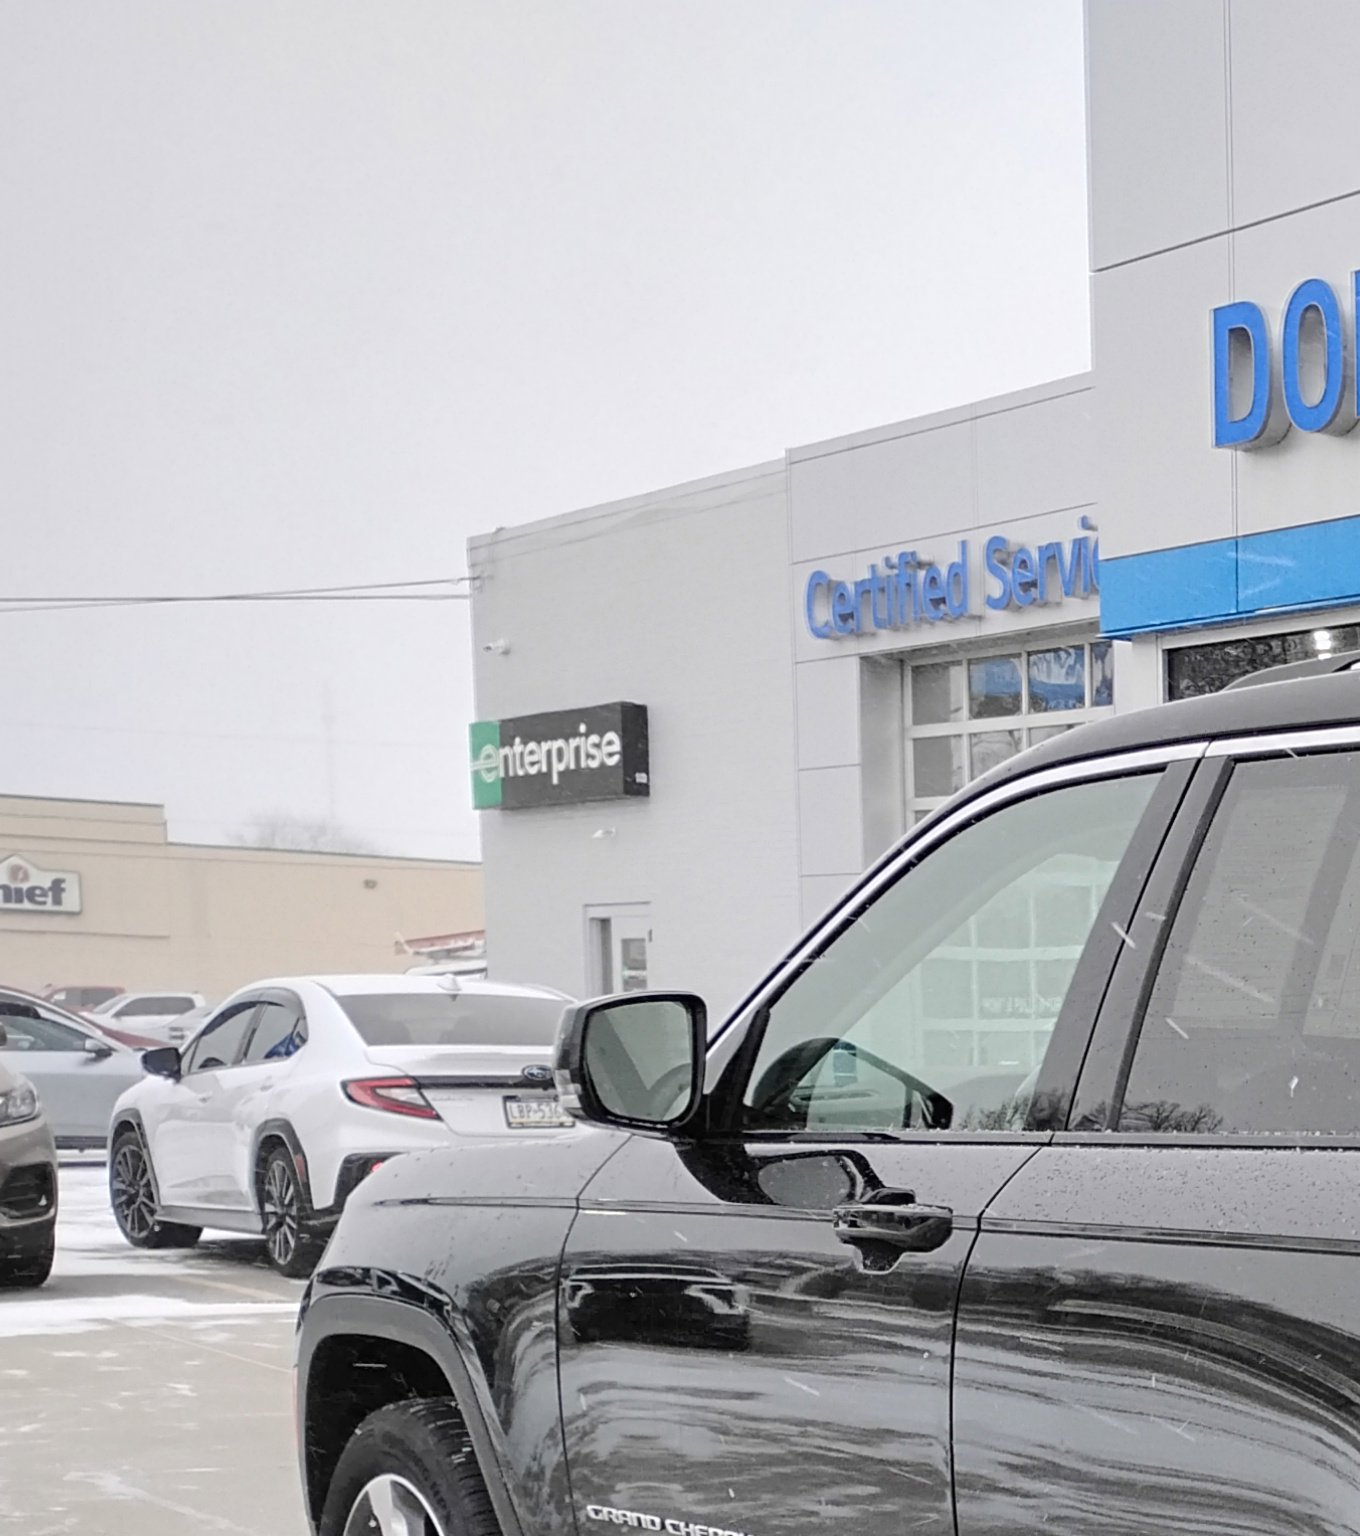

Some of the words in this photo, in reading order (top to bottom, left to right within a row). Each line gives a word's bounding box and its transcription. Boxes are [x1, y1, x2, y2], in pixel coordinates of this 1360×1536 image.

[805, 540, 971, 640] Certified
[984, 514, 1099, 611] Servi
[470, 722, 622, 785] enterprise
[586, 1504, 662, 1532] GRAND
